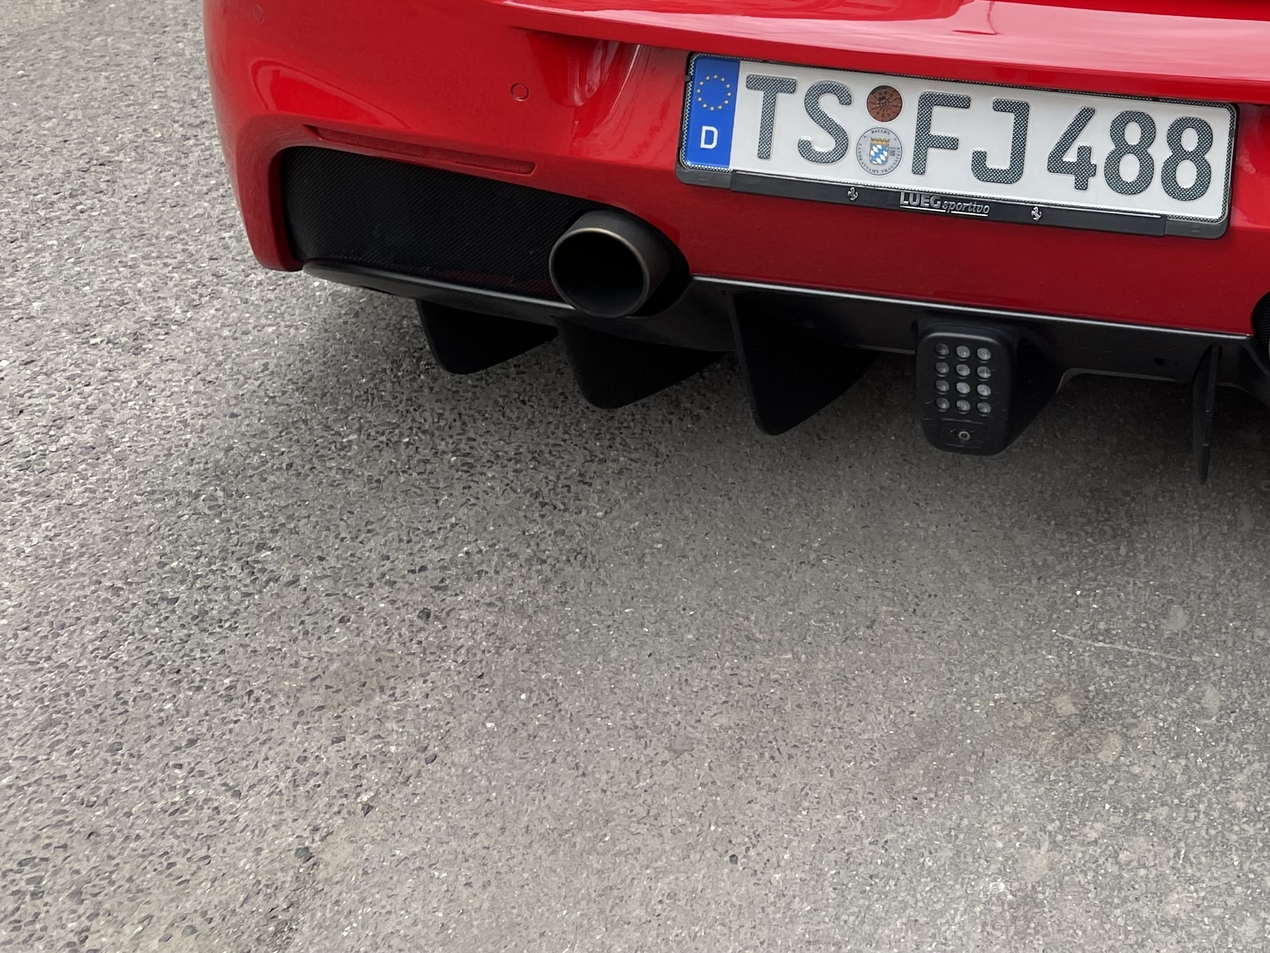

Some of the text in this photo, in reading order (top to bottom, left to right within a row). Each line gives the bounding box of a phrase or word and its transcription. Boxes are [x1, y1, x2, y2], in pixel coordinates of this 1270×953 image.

[700, 125, 719, 149] D
[746, 74, 1214, 201] TS FJ 488
[900, 191, 991, 214] LUEG sportivo
